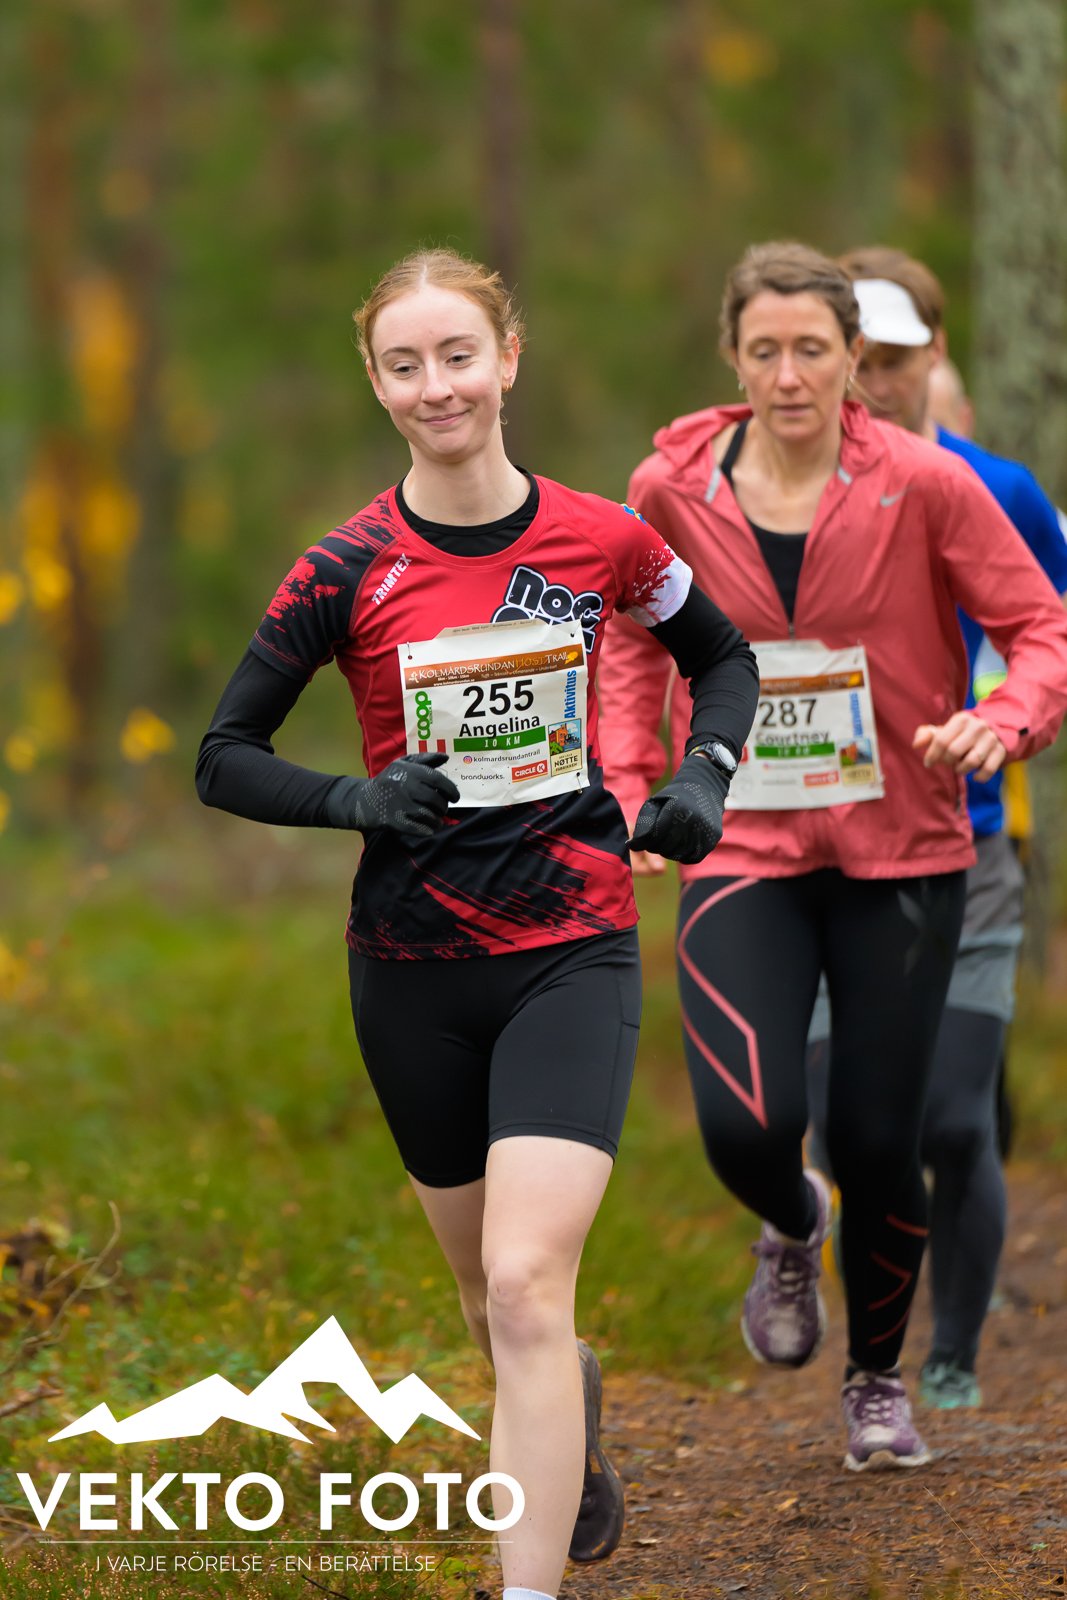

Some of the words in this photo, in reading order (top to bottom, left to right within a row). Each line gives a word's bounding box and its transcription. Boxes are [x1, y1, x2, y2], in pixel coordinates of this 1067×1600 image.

[371, 552, 412, 606] TRIMTEX
[463, 679, 534, 718] 255
[564, 669, 577, 719] Aktivitus
[415, 690, 432, 740] coop
[758, 698, 817, 728] 287
[459, 715, 540, 739] Angelina
[484, 739, 498, 748] 10
[506, 735, 521, 746] KM
[755, 731, 830, 748] Courtney
[473, 749, 541, 762] kolmardsrundantrail
[554, 754, 578, 768] NØTTE
[514, 768, 536, 777] CIRCLE
